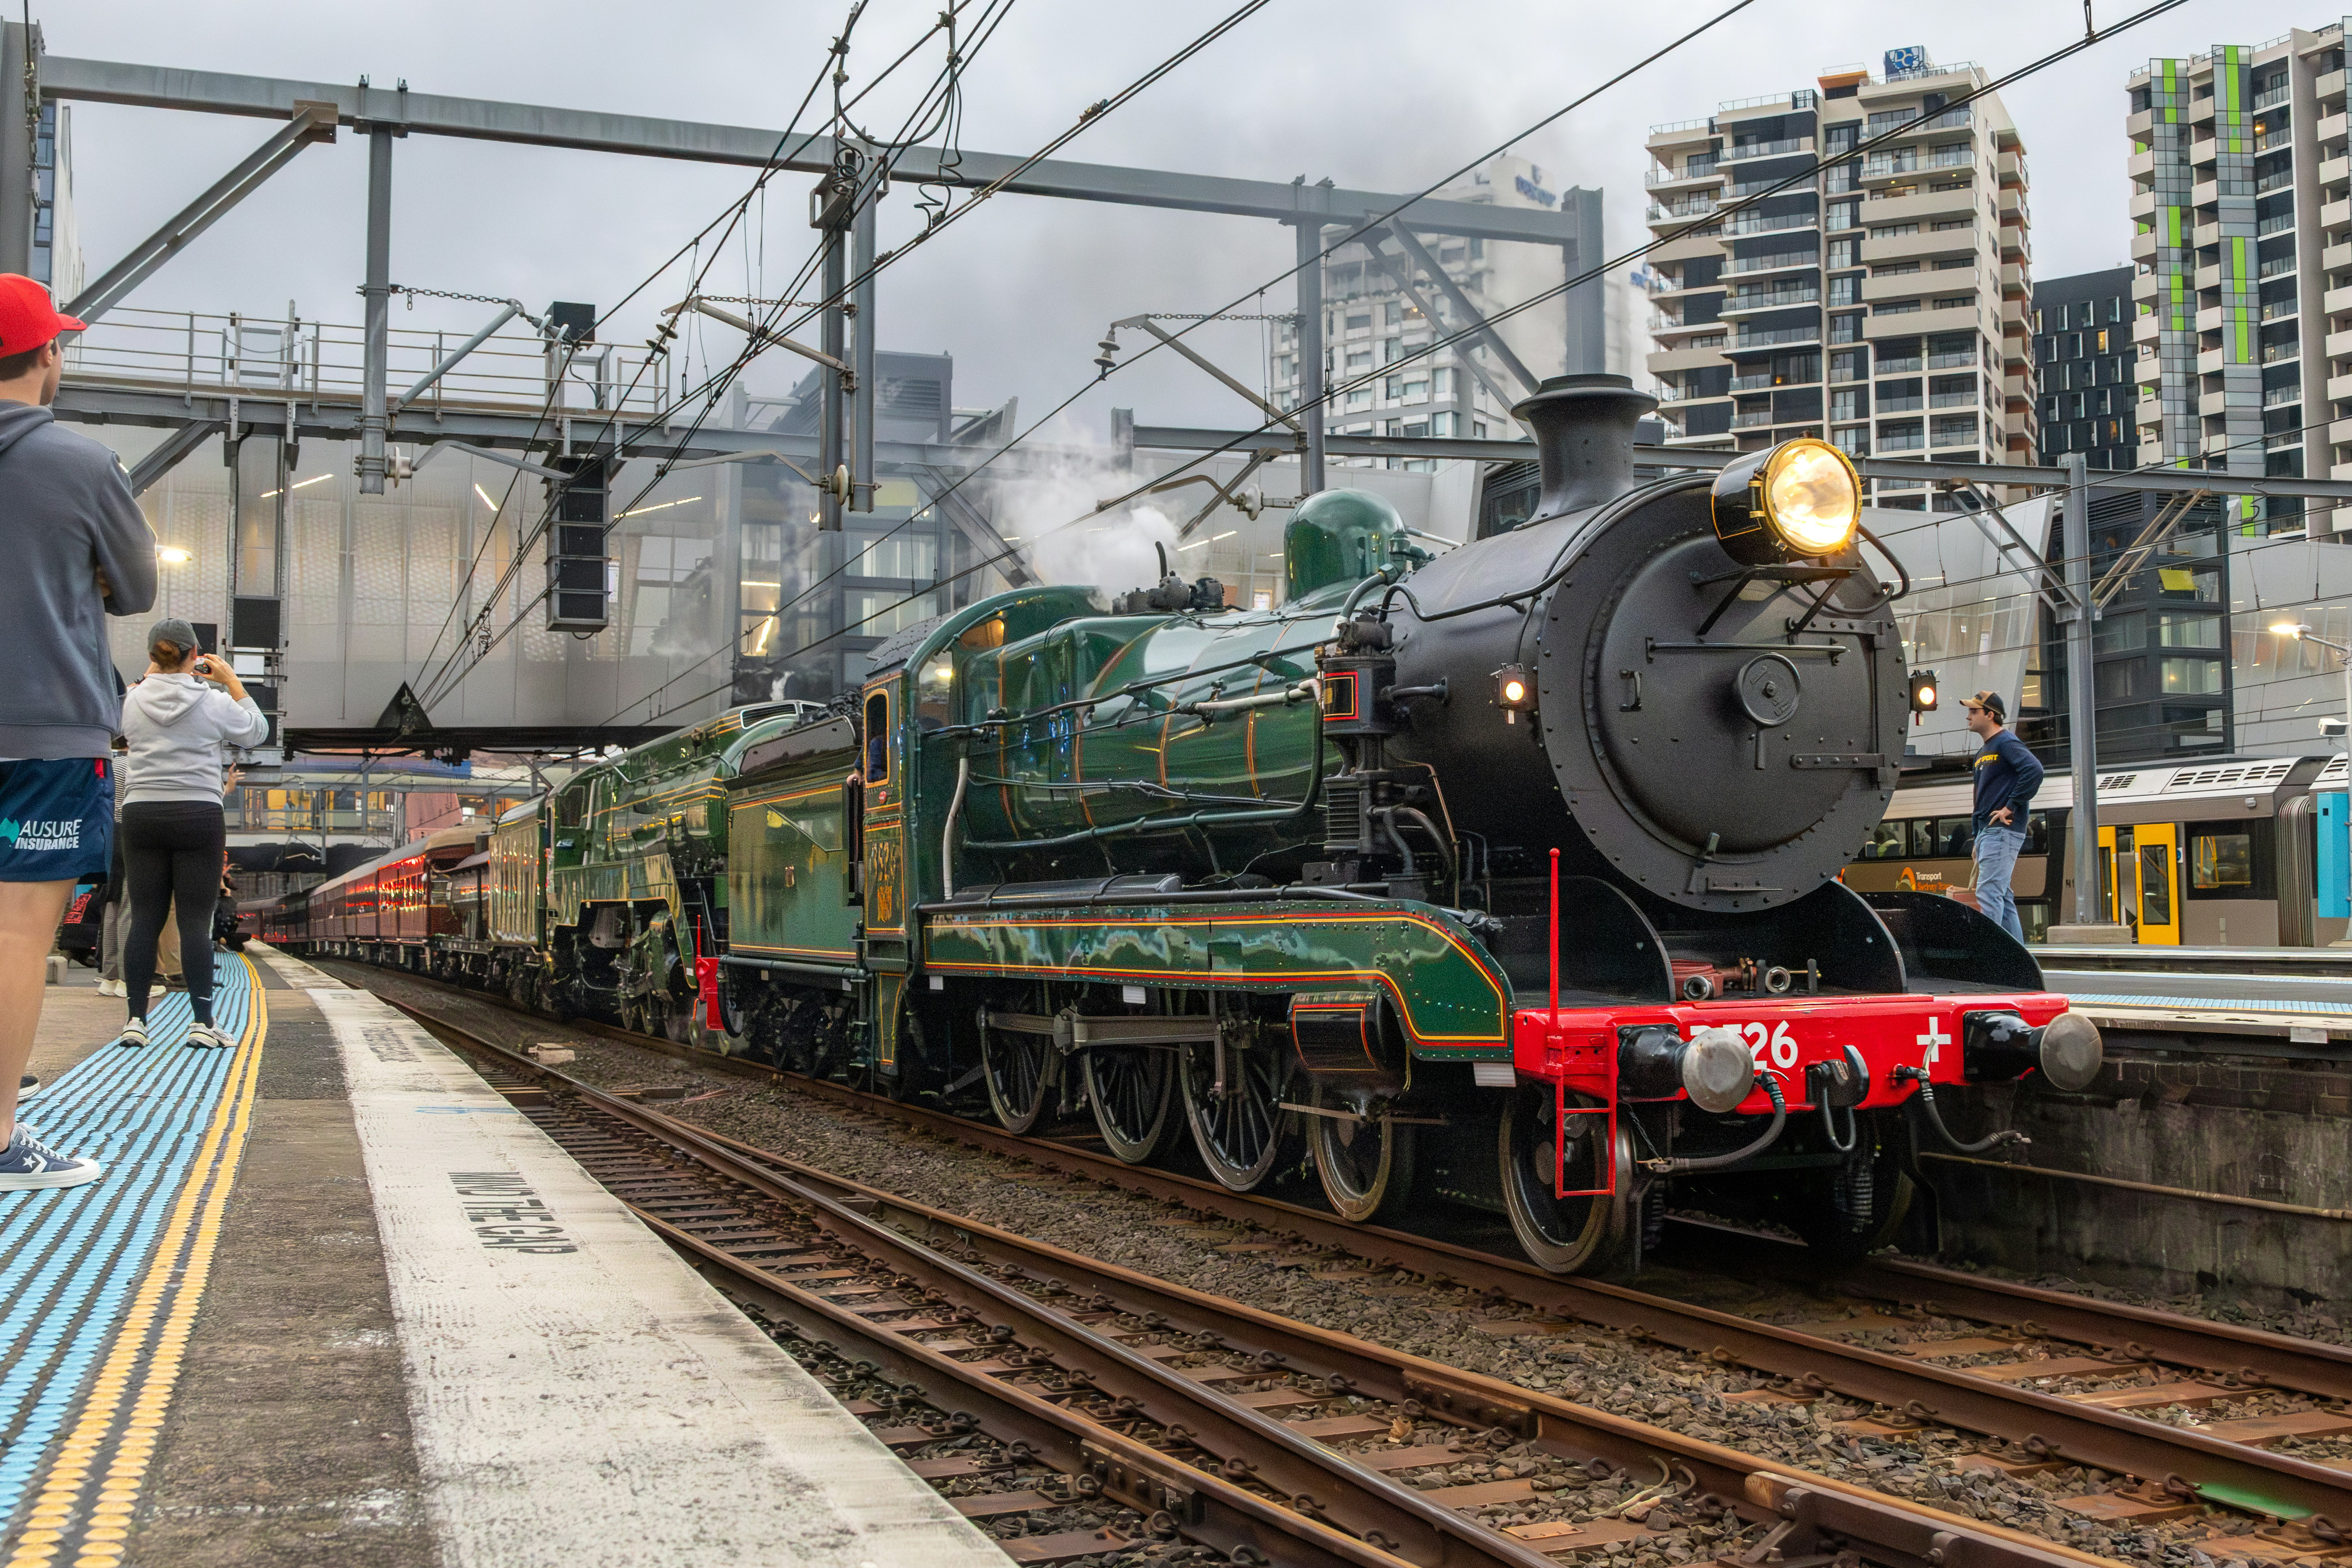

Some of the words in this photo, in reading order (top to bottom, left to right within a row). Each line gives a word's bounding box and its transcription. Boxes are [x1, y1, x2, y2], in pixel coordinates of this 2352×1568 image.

[19, 819, 82, 838] AUSURE
[15, 836, 79, 851] INSURANCE
[1916, 872, 1941, 882] Transport
[1690, 1020, 1798, 1070] 26
[448, 1172, 534, 1196] MIND
[462, 1199, 555, 1222] THE
[474, 1225, 578, 1254] GAP
